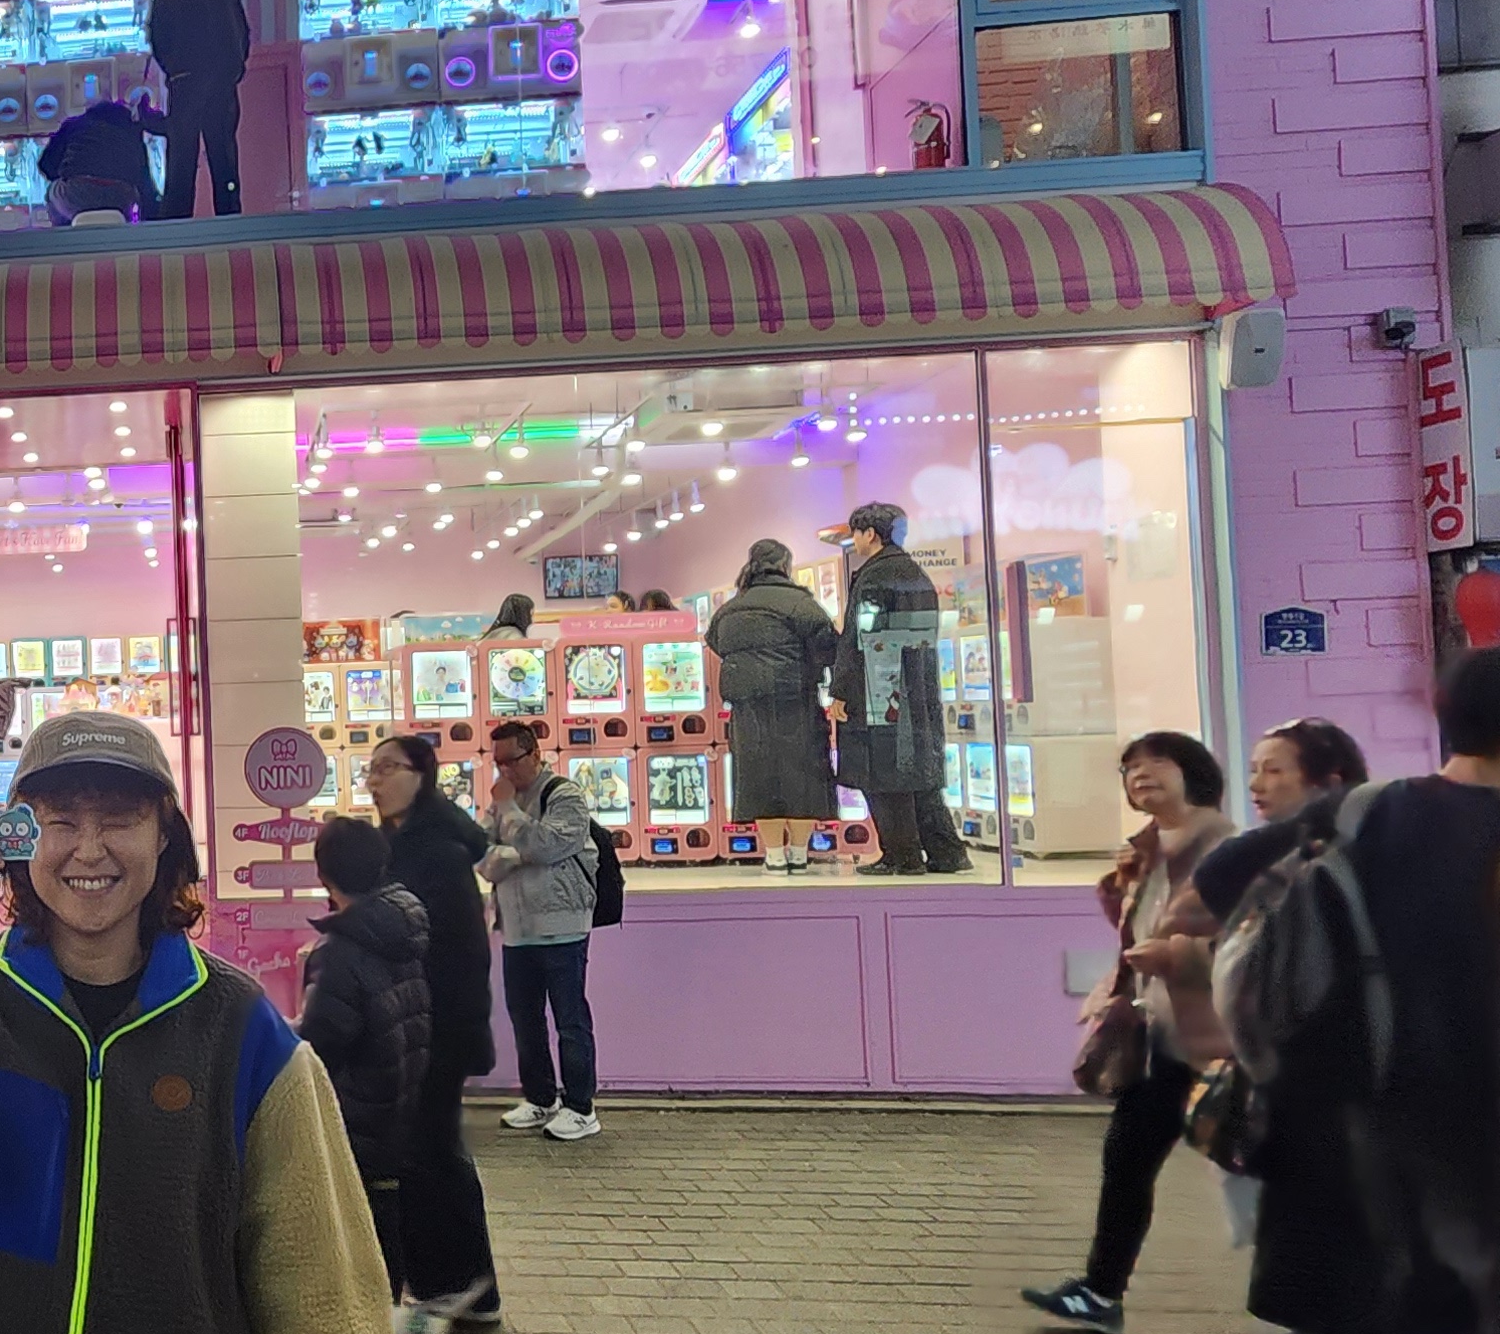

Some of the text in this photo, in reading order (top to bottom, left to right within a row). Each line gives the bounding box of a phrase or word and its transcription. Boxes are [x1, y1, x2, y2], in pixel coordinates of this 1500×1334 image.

[1420, 351, 1468, 542] 도장
[918, 558, 957, 566] HANGE
[1280, 629, 1307, 648] 23
[61, 732, 126, 746] Supreme
[258, 764, 312, 791] NINI
[235, 822, 318, 843] 4F Rooftop
[236, 870, 250, 881] 3F
[236, 912, 249, 921] 2F
[237, 949, 248, 959] 1F
